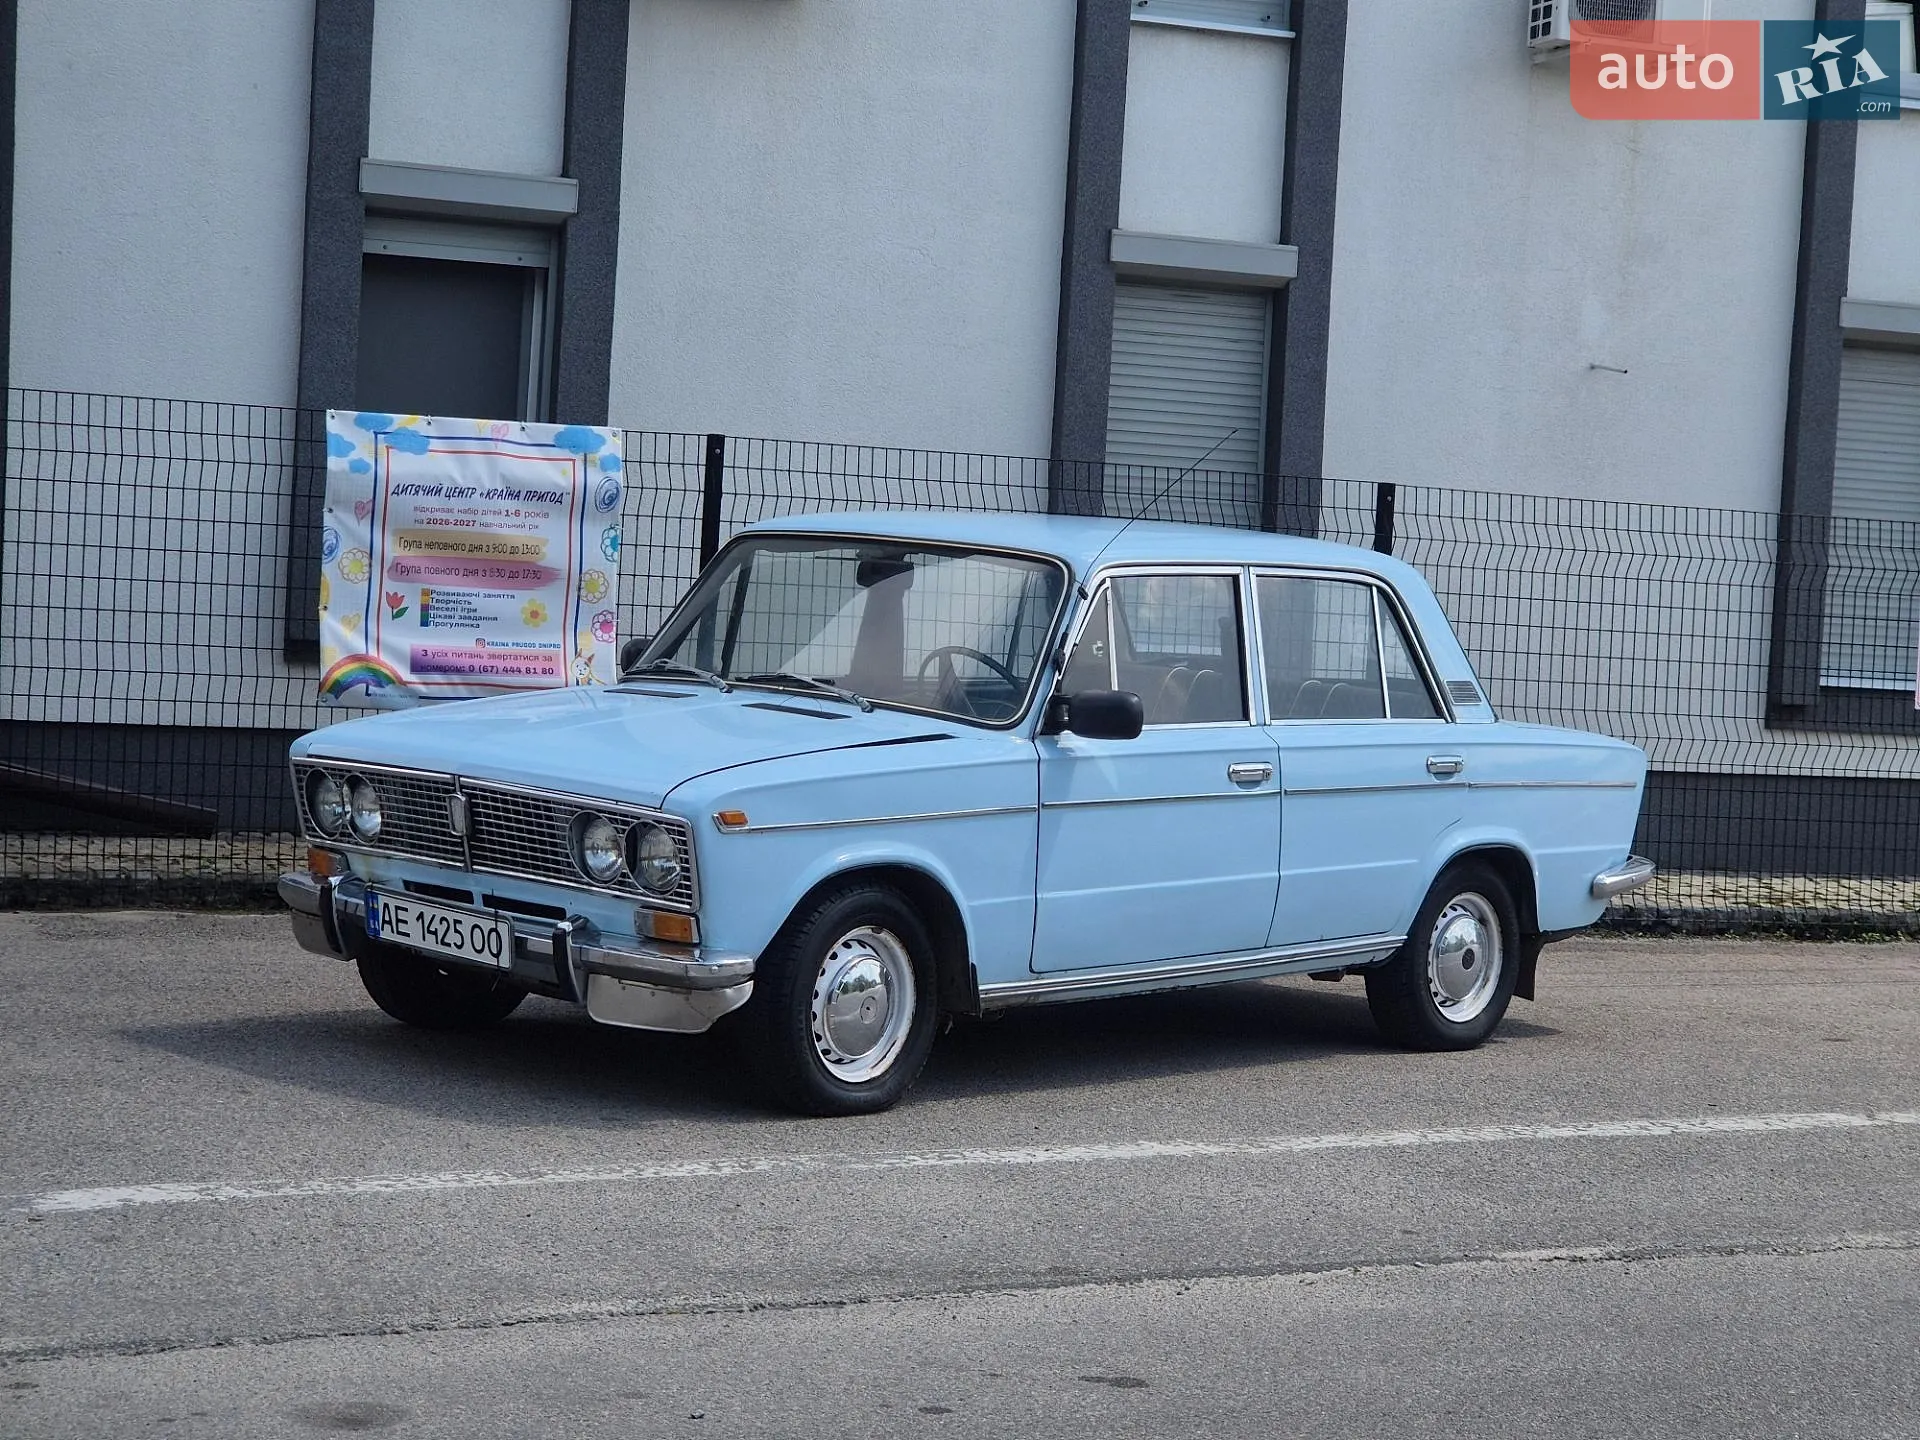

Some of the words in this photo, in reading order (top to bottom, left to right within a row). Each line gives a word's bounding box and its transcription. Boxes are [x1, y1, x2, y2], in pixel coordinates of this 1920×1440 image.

[391, 483, 443, 497] ДИТЯЧИЙ
[444, 486, 477, 501] ЦЕНТР
[480, 486, 521, 502] «КРАЇНА
[457, 508, 479, 516] набір
[504, 509, 521, 518] 1-6
[524, 511, 550, 519] років
[426, 517, 477, 527] 2026-2027
[479, 521, 526, 529] навчальний
[398, 536, 422, 552] Група
[424, 540, 467, 552] неповного
[468, 543, 484, 553] дня
[491, 543, 508, 554] 9:00
[509, 545, 520, 555] до
[521, 543, 541, 555] 13:00
[395, 562, 422, 576] Група
[424, 566, 460, 576] повного
[462, 567, 479, 577] дня
[481, 569, 487, 578] з
[508, 570, 519, 579] до
[430, 589, 480, 597] Розвиваючі
[430, 597, 473, 606] Творчість
[460, 606, 478, 614] ігри
[429, 620, 481, 629] Прогулянка
[431, 651, 449, 659] усіх
[451, 652, 485, 660] питань
[478, 664, 499, 674] (67)
[502, 665, 522, 674] 444
[380, 902, 411, 938] AE
[415, 910, 465, 950] 1425
